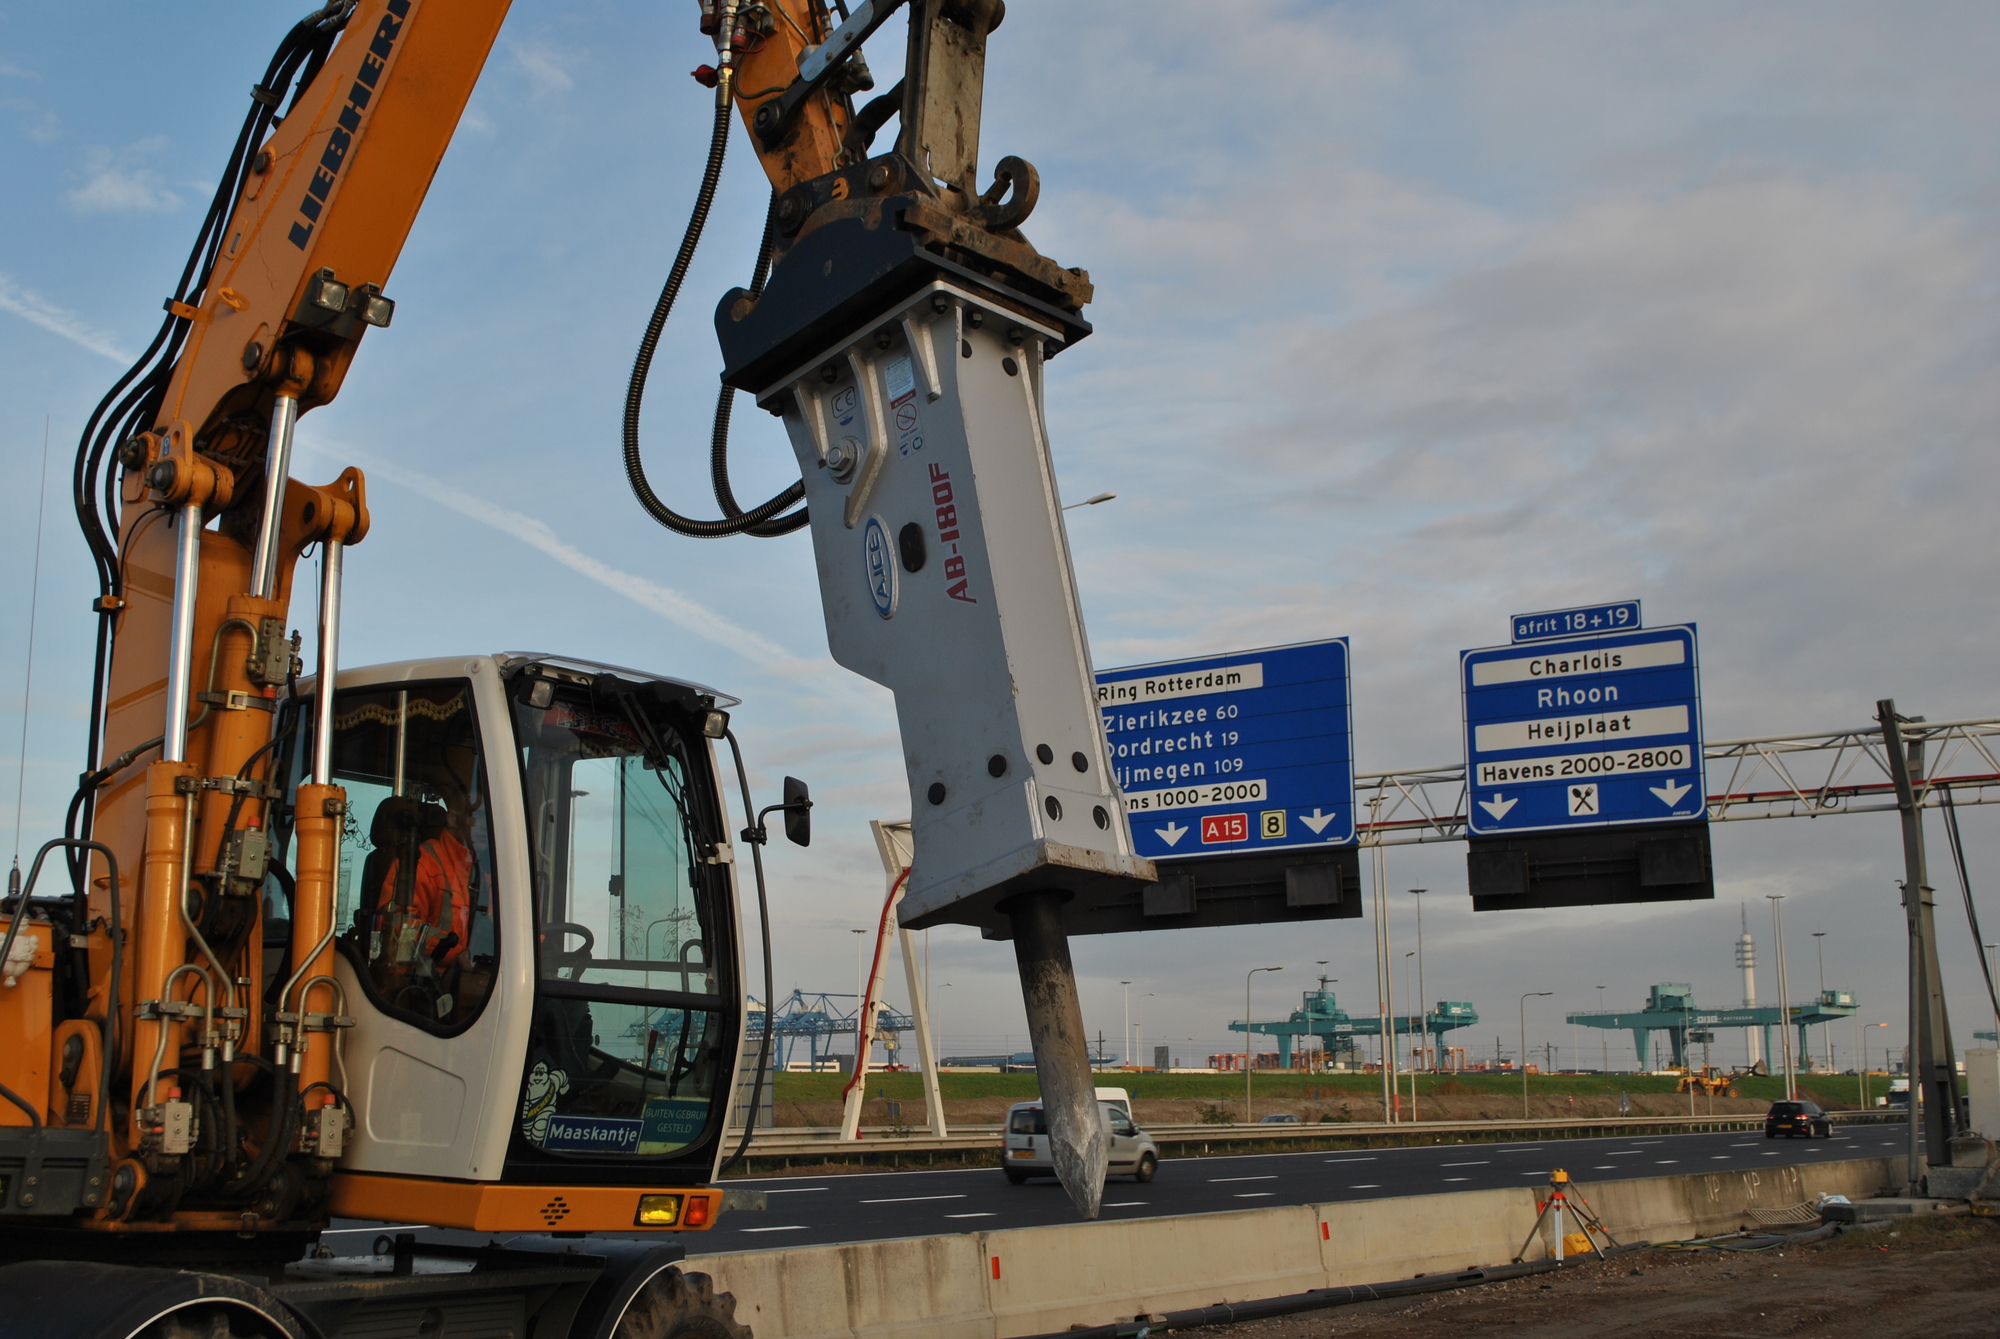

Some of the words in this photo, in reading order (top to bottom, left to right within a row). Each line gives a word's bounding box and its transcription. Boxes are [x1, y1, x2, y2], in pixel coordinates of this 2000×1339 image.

[928, 462, 977, 604] AB-180F
[1519, 619, 1557, 635] afrit
[1529, 652, 1622, 676] Charlois
[1098, 683, 1138, 701] Ring
[1145, 671, 1242, 695] Rotterdam
[1537, 685, 1618, 708] Rhoon
[1103, 707, 1207, 733] Zierikzee
[1216, 704, 1239, 720] 60
[1528, 714, 1631, 741] Heijplaat
[1221, 731, 1239, 746] 19
[1117, 760, 1205, 789] ijmegen
[1214, 758, 1243, 773] 109
[1483, 763, 1555, 783] Havens
[1560, 749, 1683, 775] 2000-2800
[1156, 783, 1261, 808] 1000-2000
[1266, 817, 1280, 834] 8
[645, 1108, 675, 1119] BUITEN
[549, 1123, 638, 1147] Maaskantje
[657, 1123, 692, 1134] GESTELD
[1743, 1172, 1760, 1200] NP
